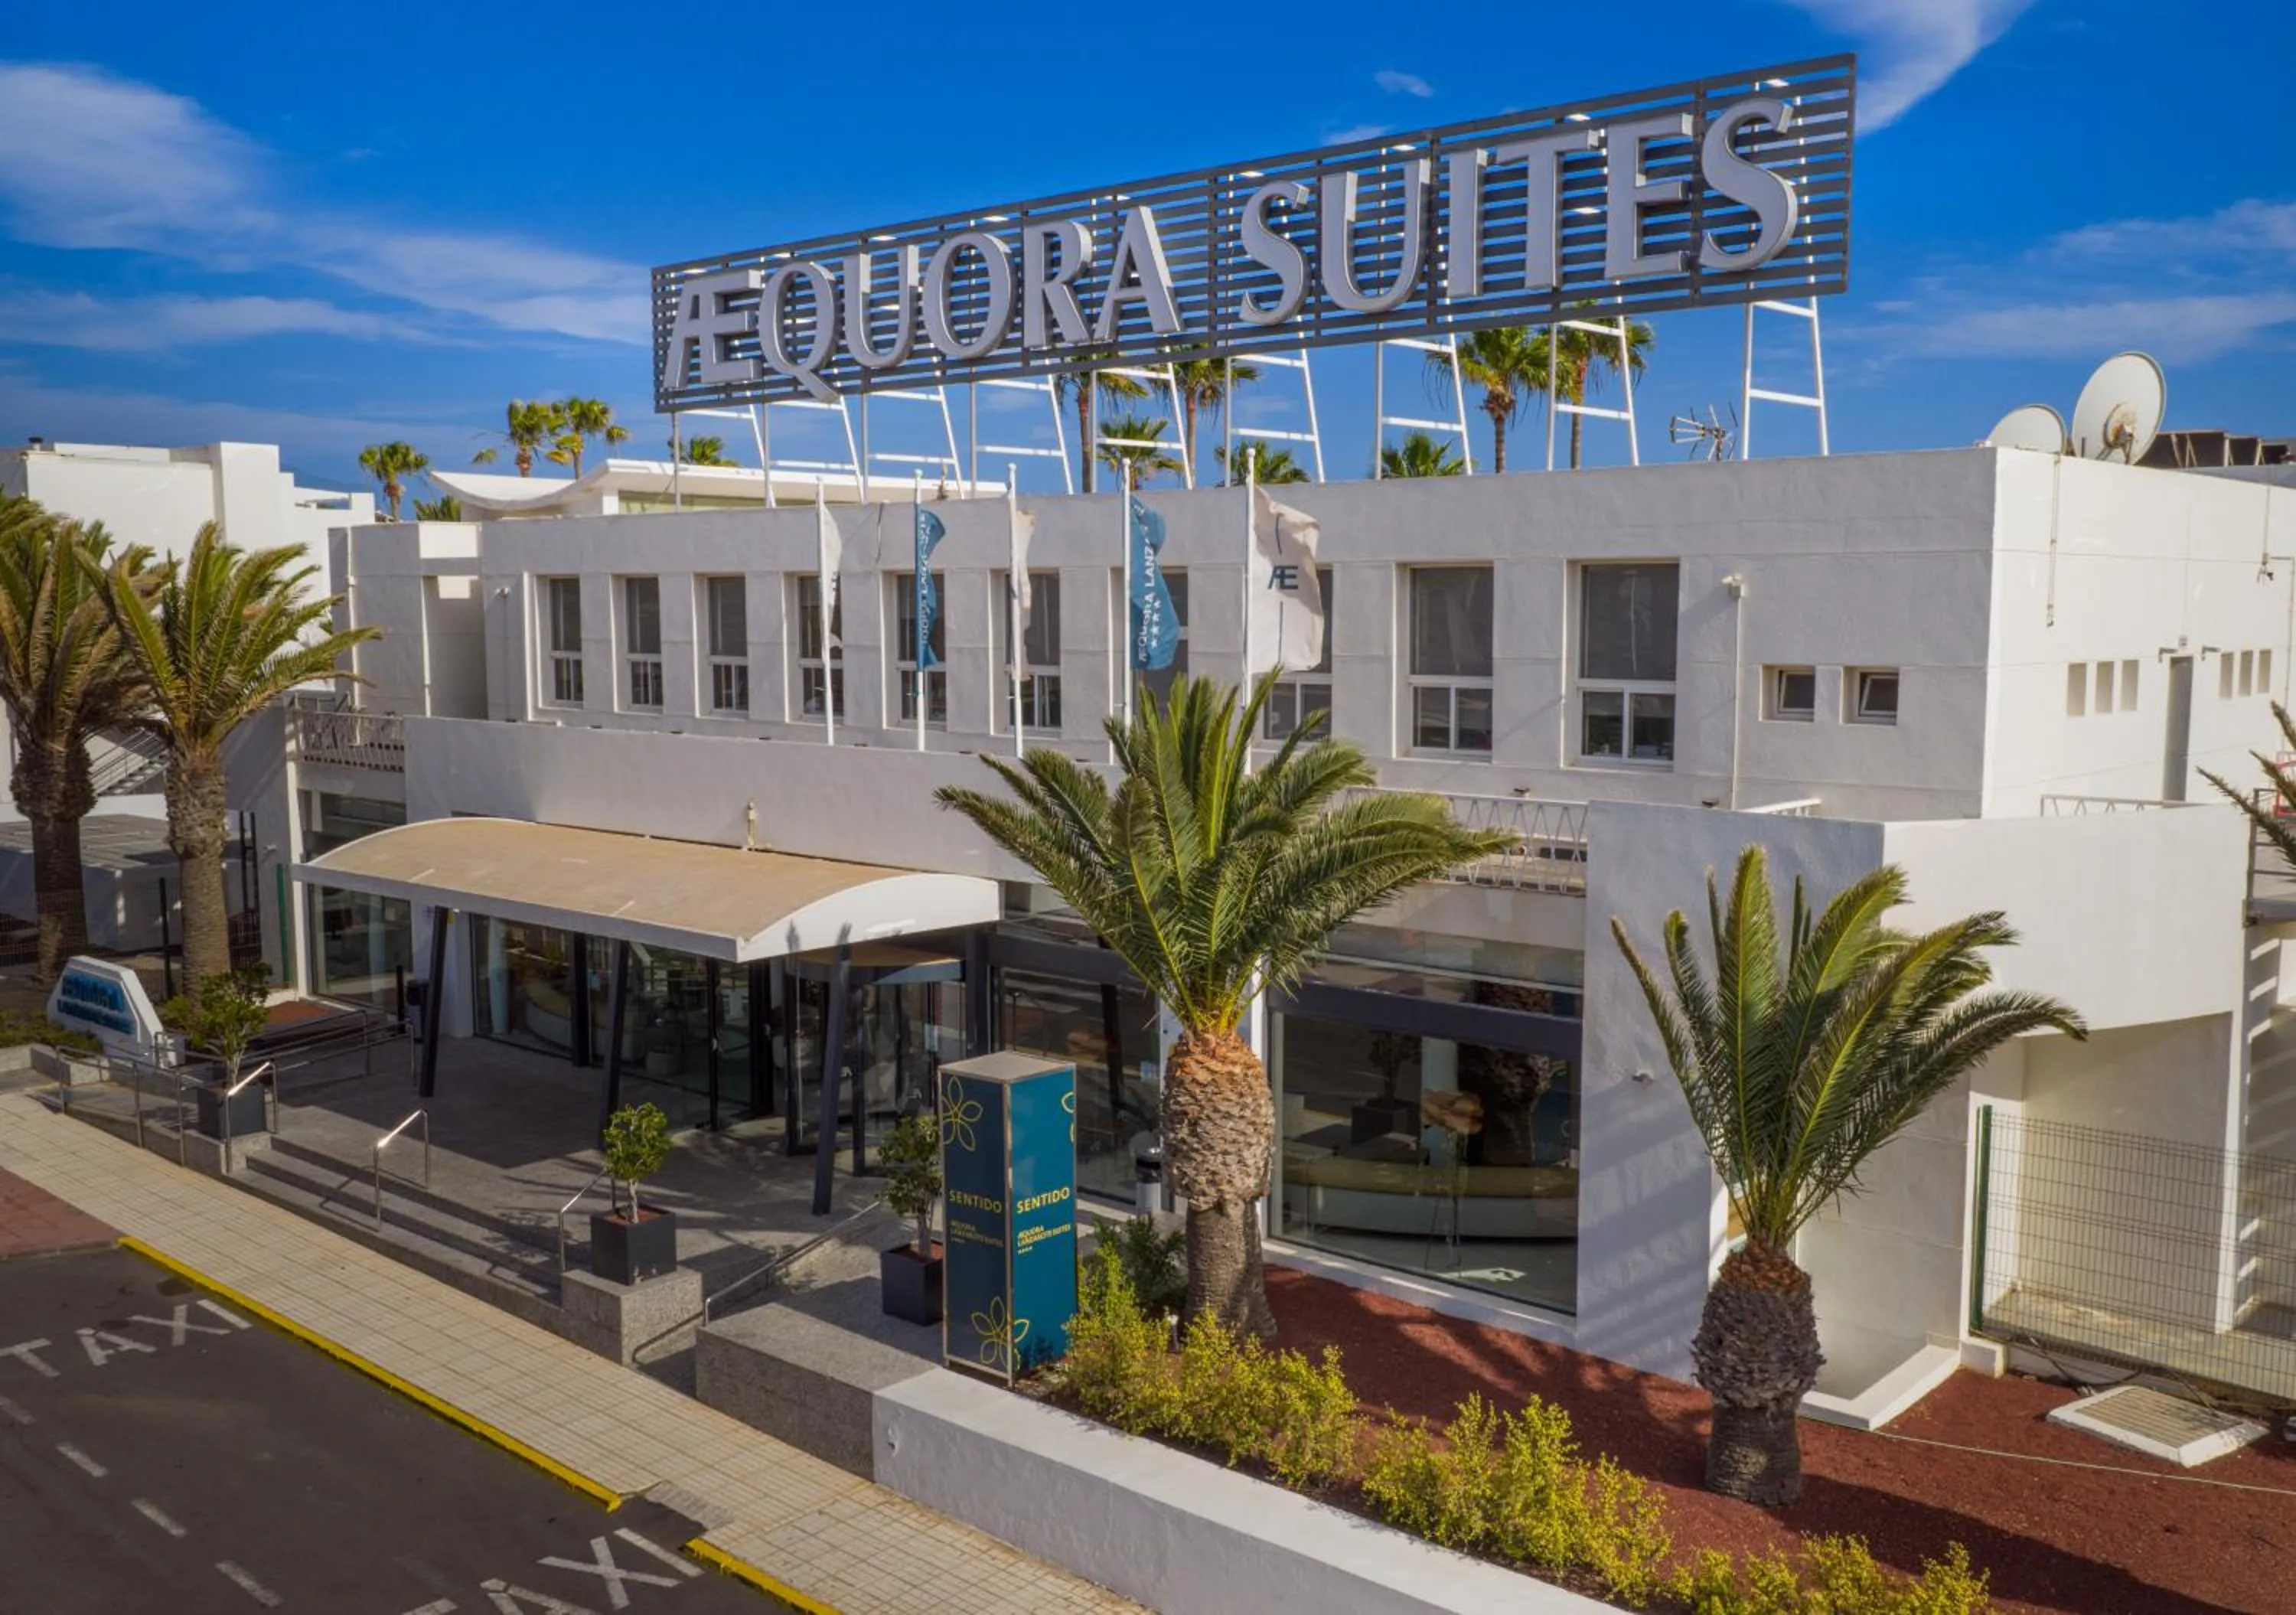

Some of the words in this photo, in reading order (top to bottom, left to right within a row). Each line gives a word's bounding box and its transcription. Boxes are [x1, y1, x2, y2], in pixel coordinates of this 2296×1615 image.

[663, 205, 1185, 404] ÆQUORA
[1238, 96, 1799, 326] SUITES
[948, 1189, 1003, 1214] SENTIDO
[1016, 1186, 1071, 1214] SENTIDO
[0, 1299, 253, 1377] TAXI
